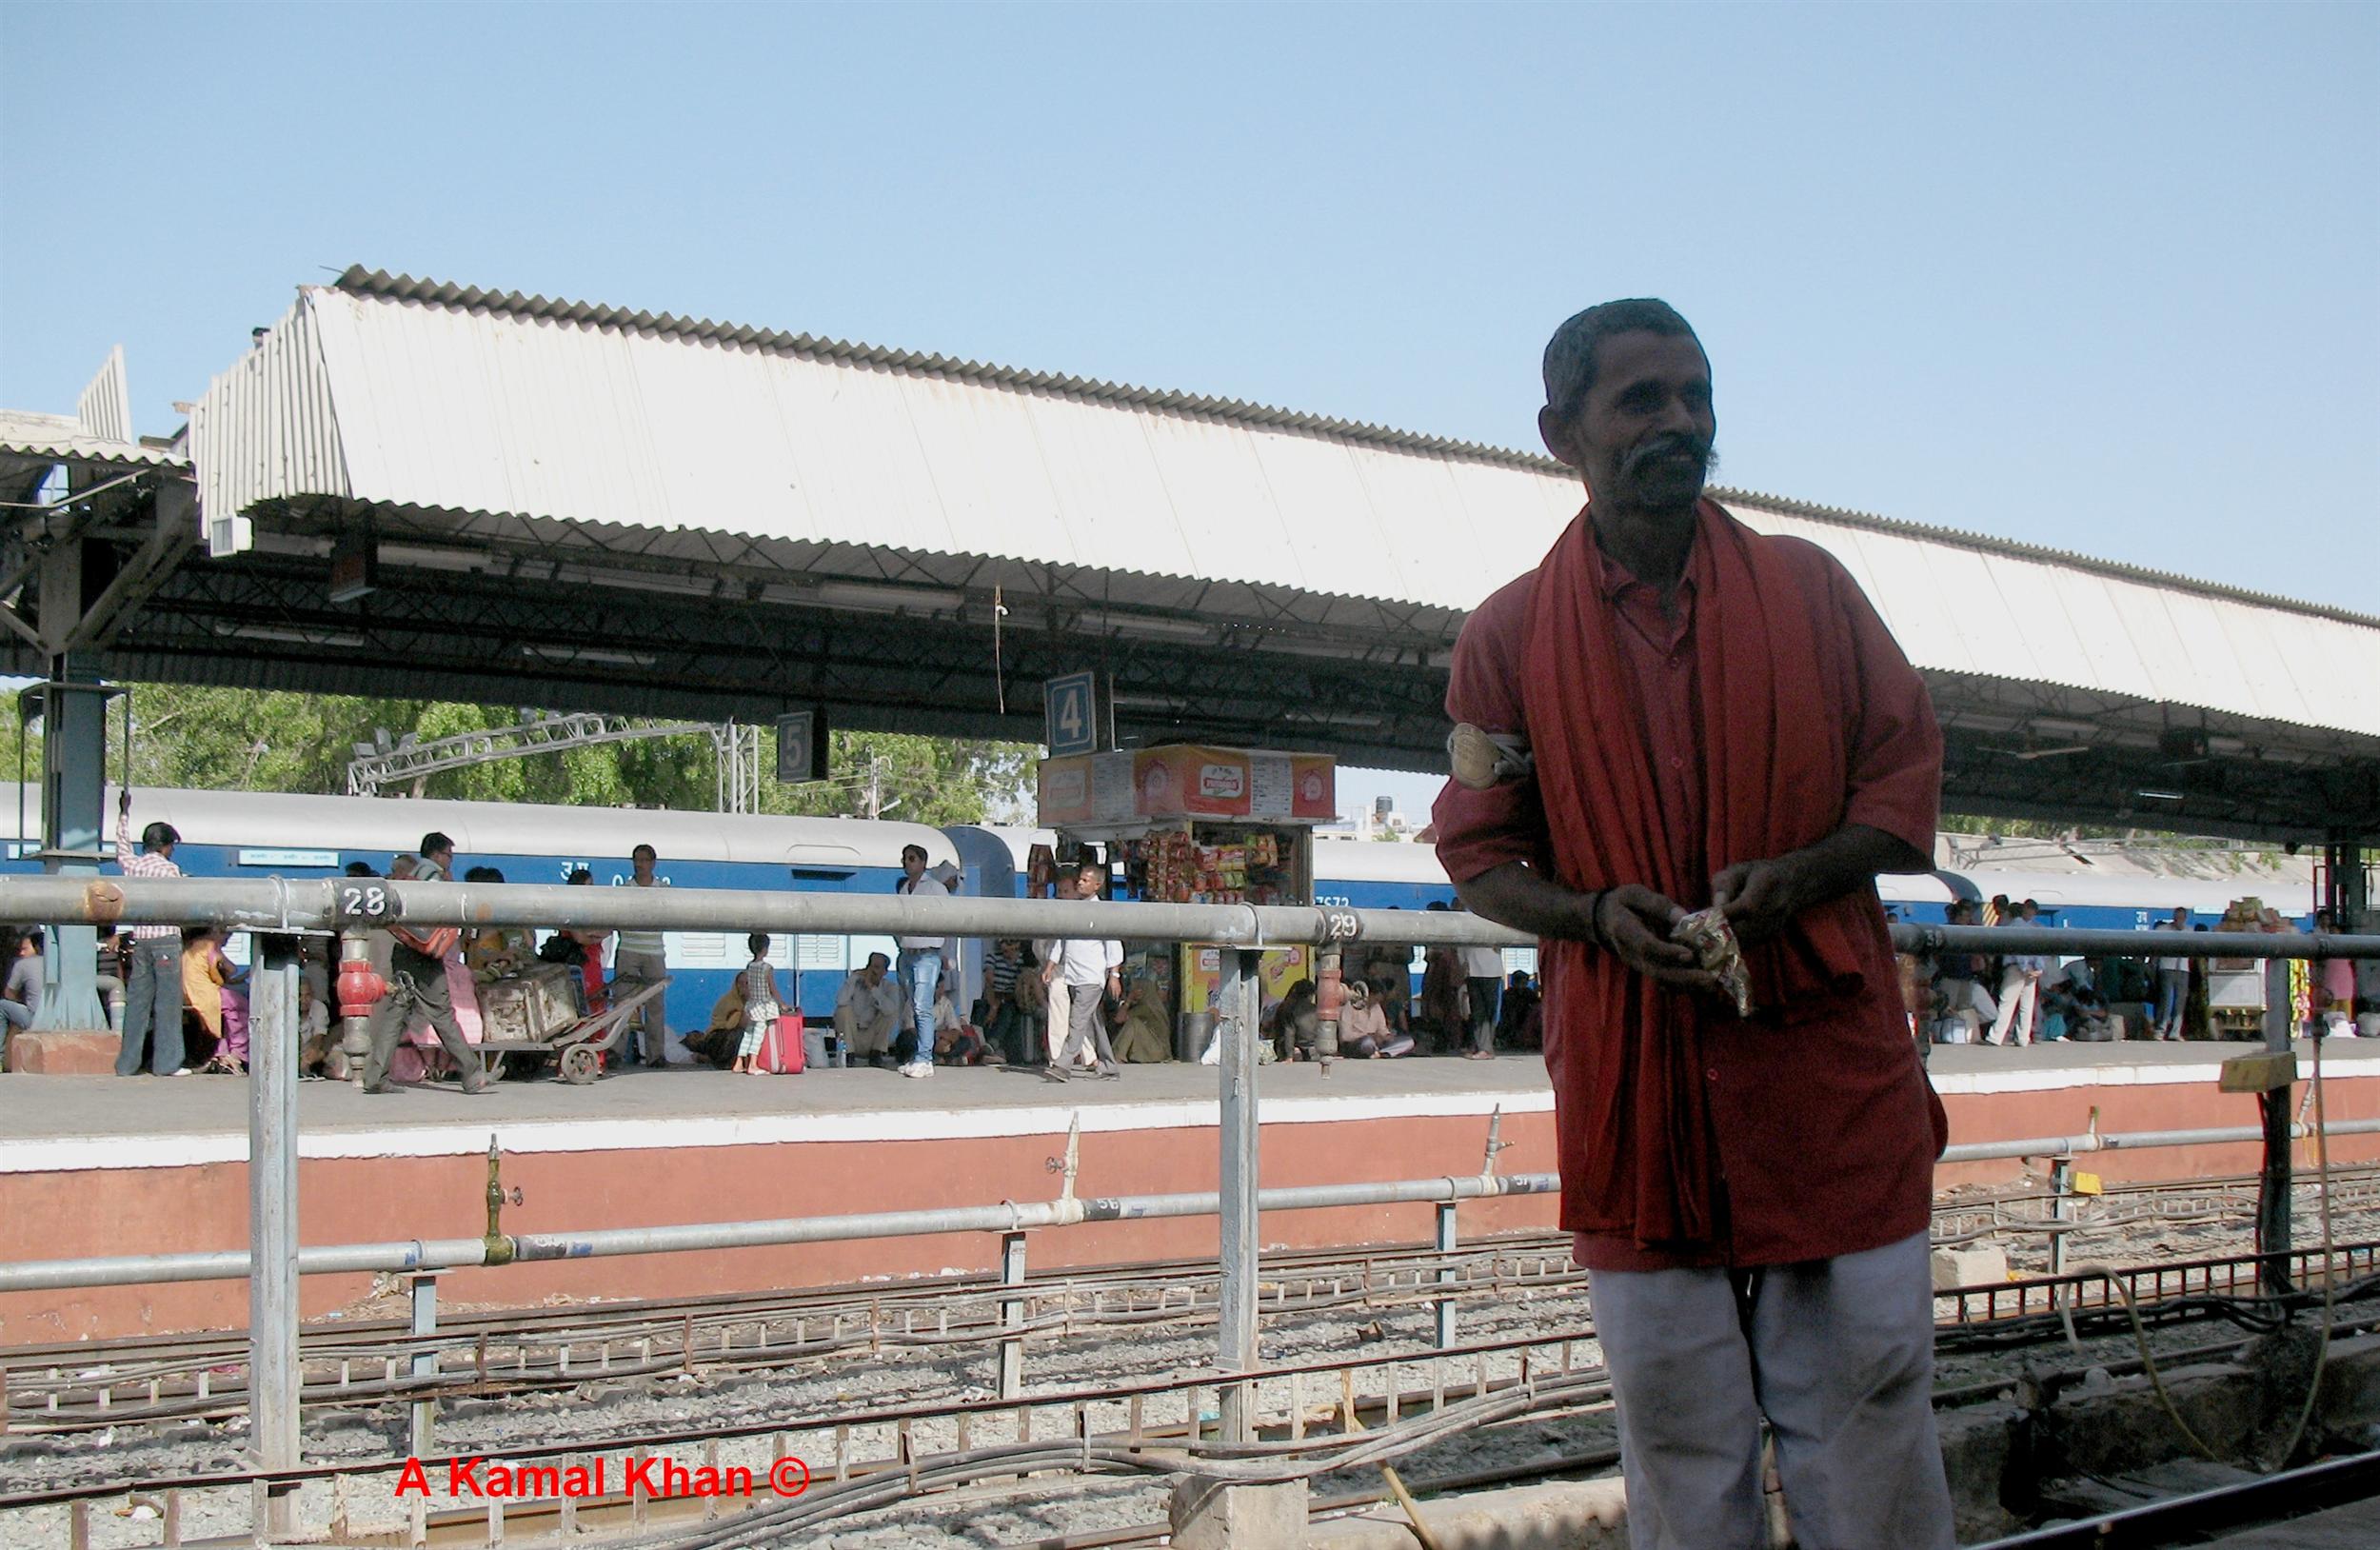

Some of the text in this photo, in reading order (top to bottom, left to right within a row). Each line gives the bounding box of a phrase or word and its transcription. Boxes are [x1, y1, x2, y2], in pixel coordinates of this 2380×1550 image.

[1061, 689, 1081, 739] 4
[785, 725, 802, 767] 5
[344, 886, 386, 916] 28
[1330, 913, 1358, 938] 29
